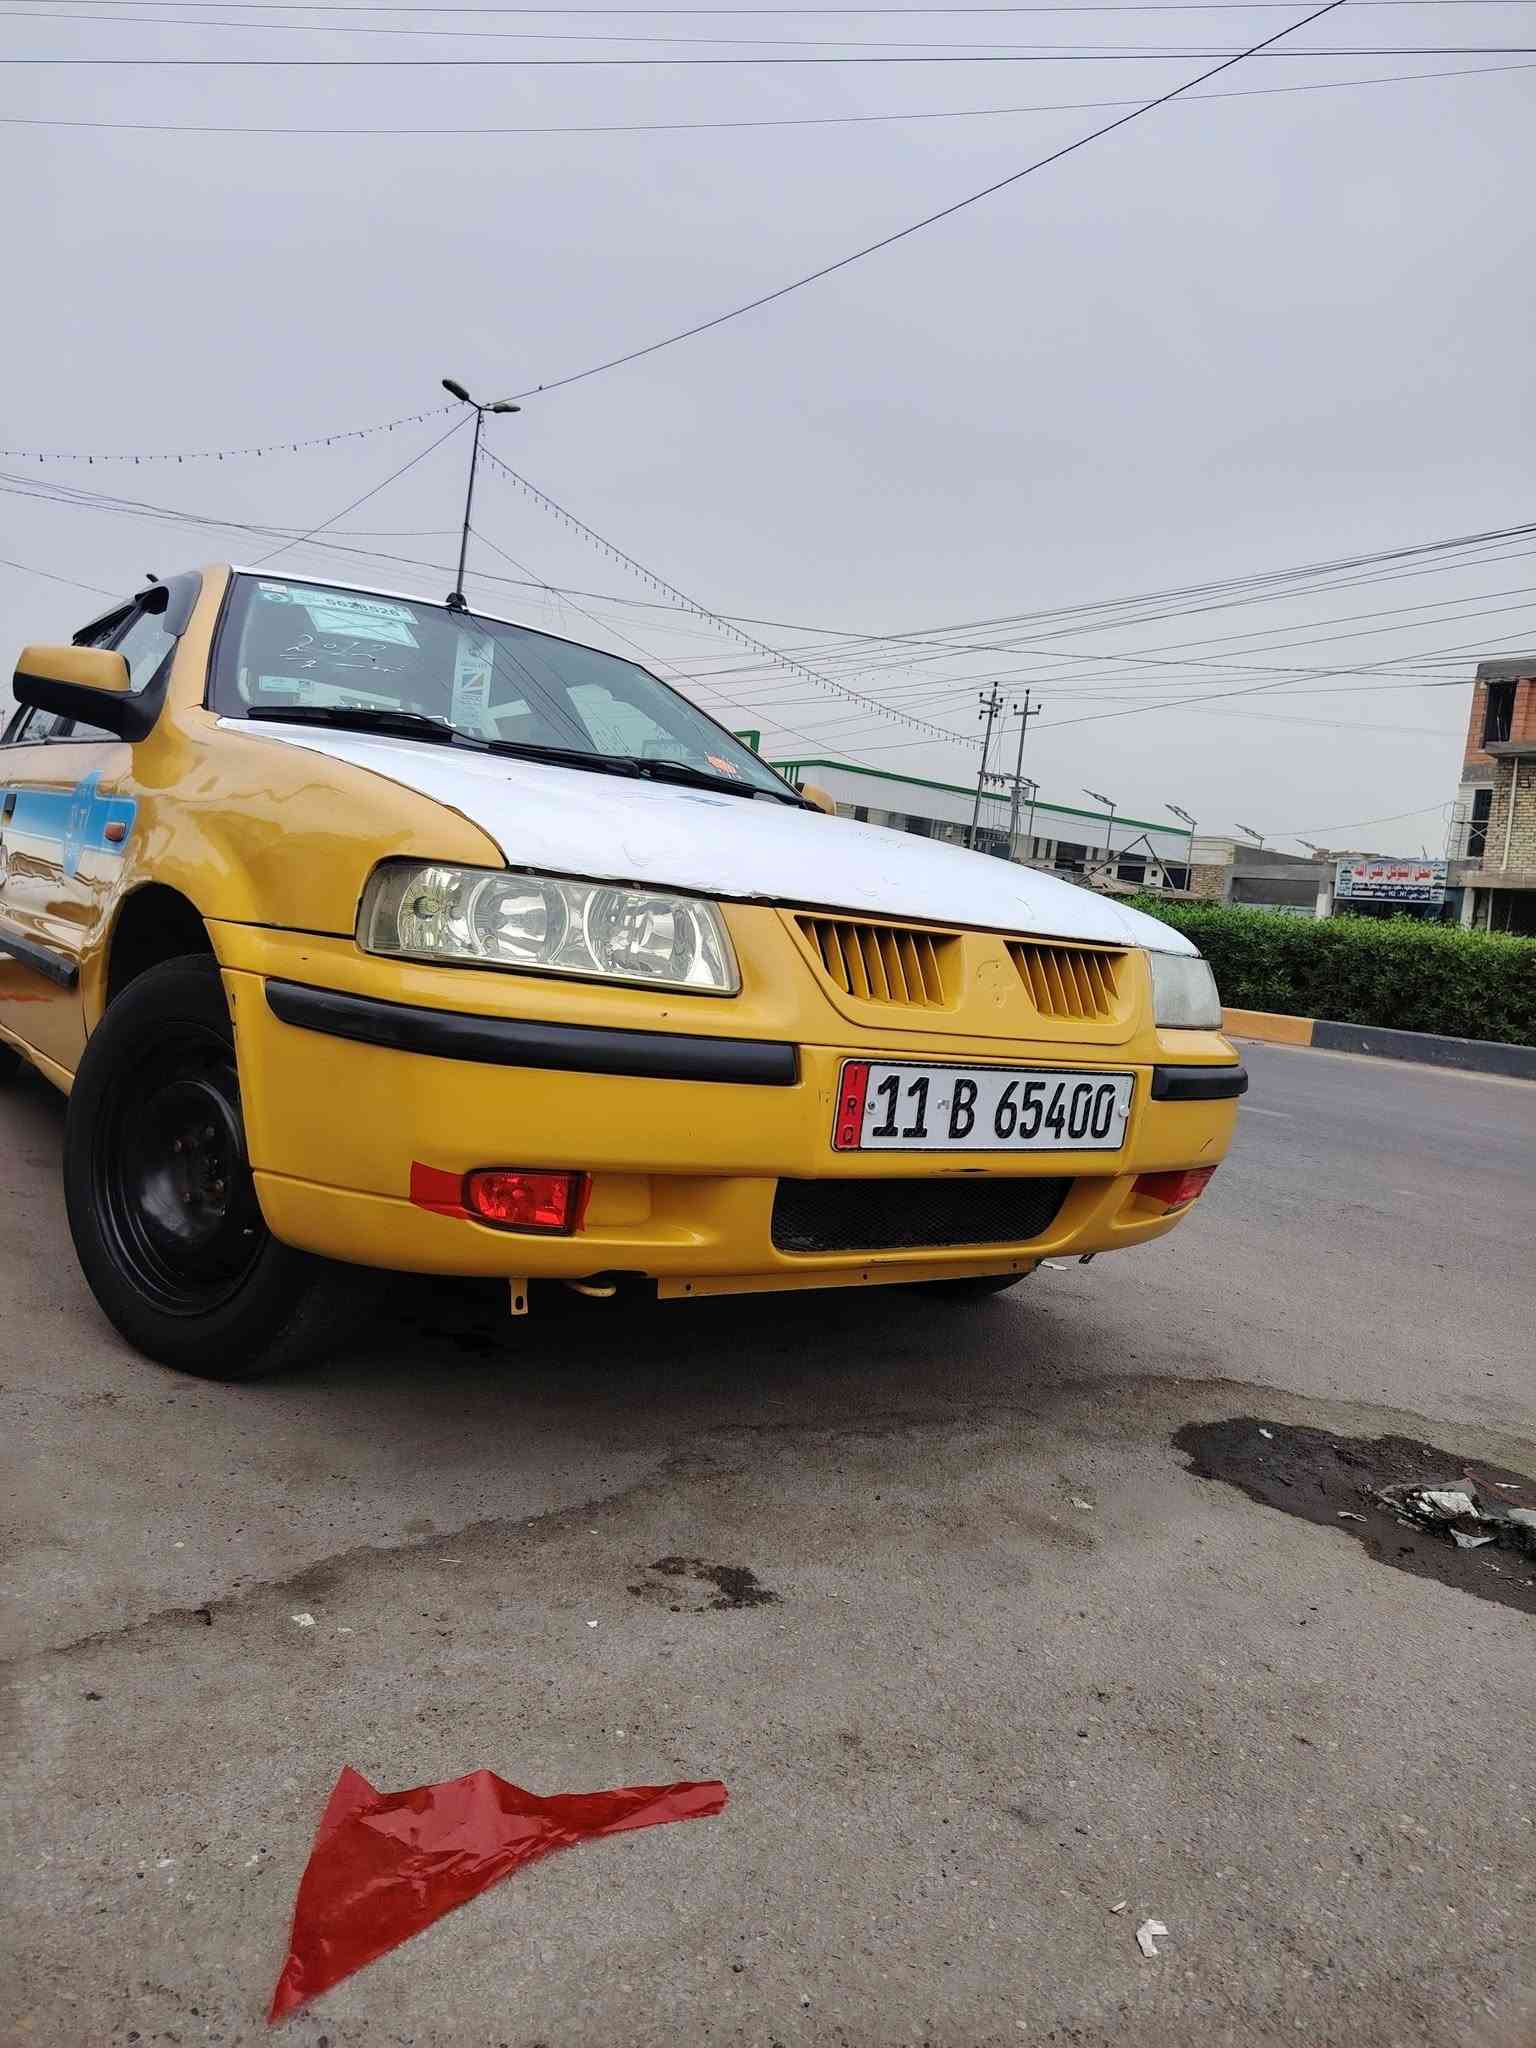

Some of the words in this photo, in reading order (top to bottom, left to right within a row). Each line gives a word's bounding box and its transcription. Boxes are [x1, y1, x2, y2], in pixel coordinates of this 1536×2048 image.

[872, 1074, 930, 1138] 11
[948, 1077, 978, 1139] B
[994, 1080, 1116, 1140] 65400
